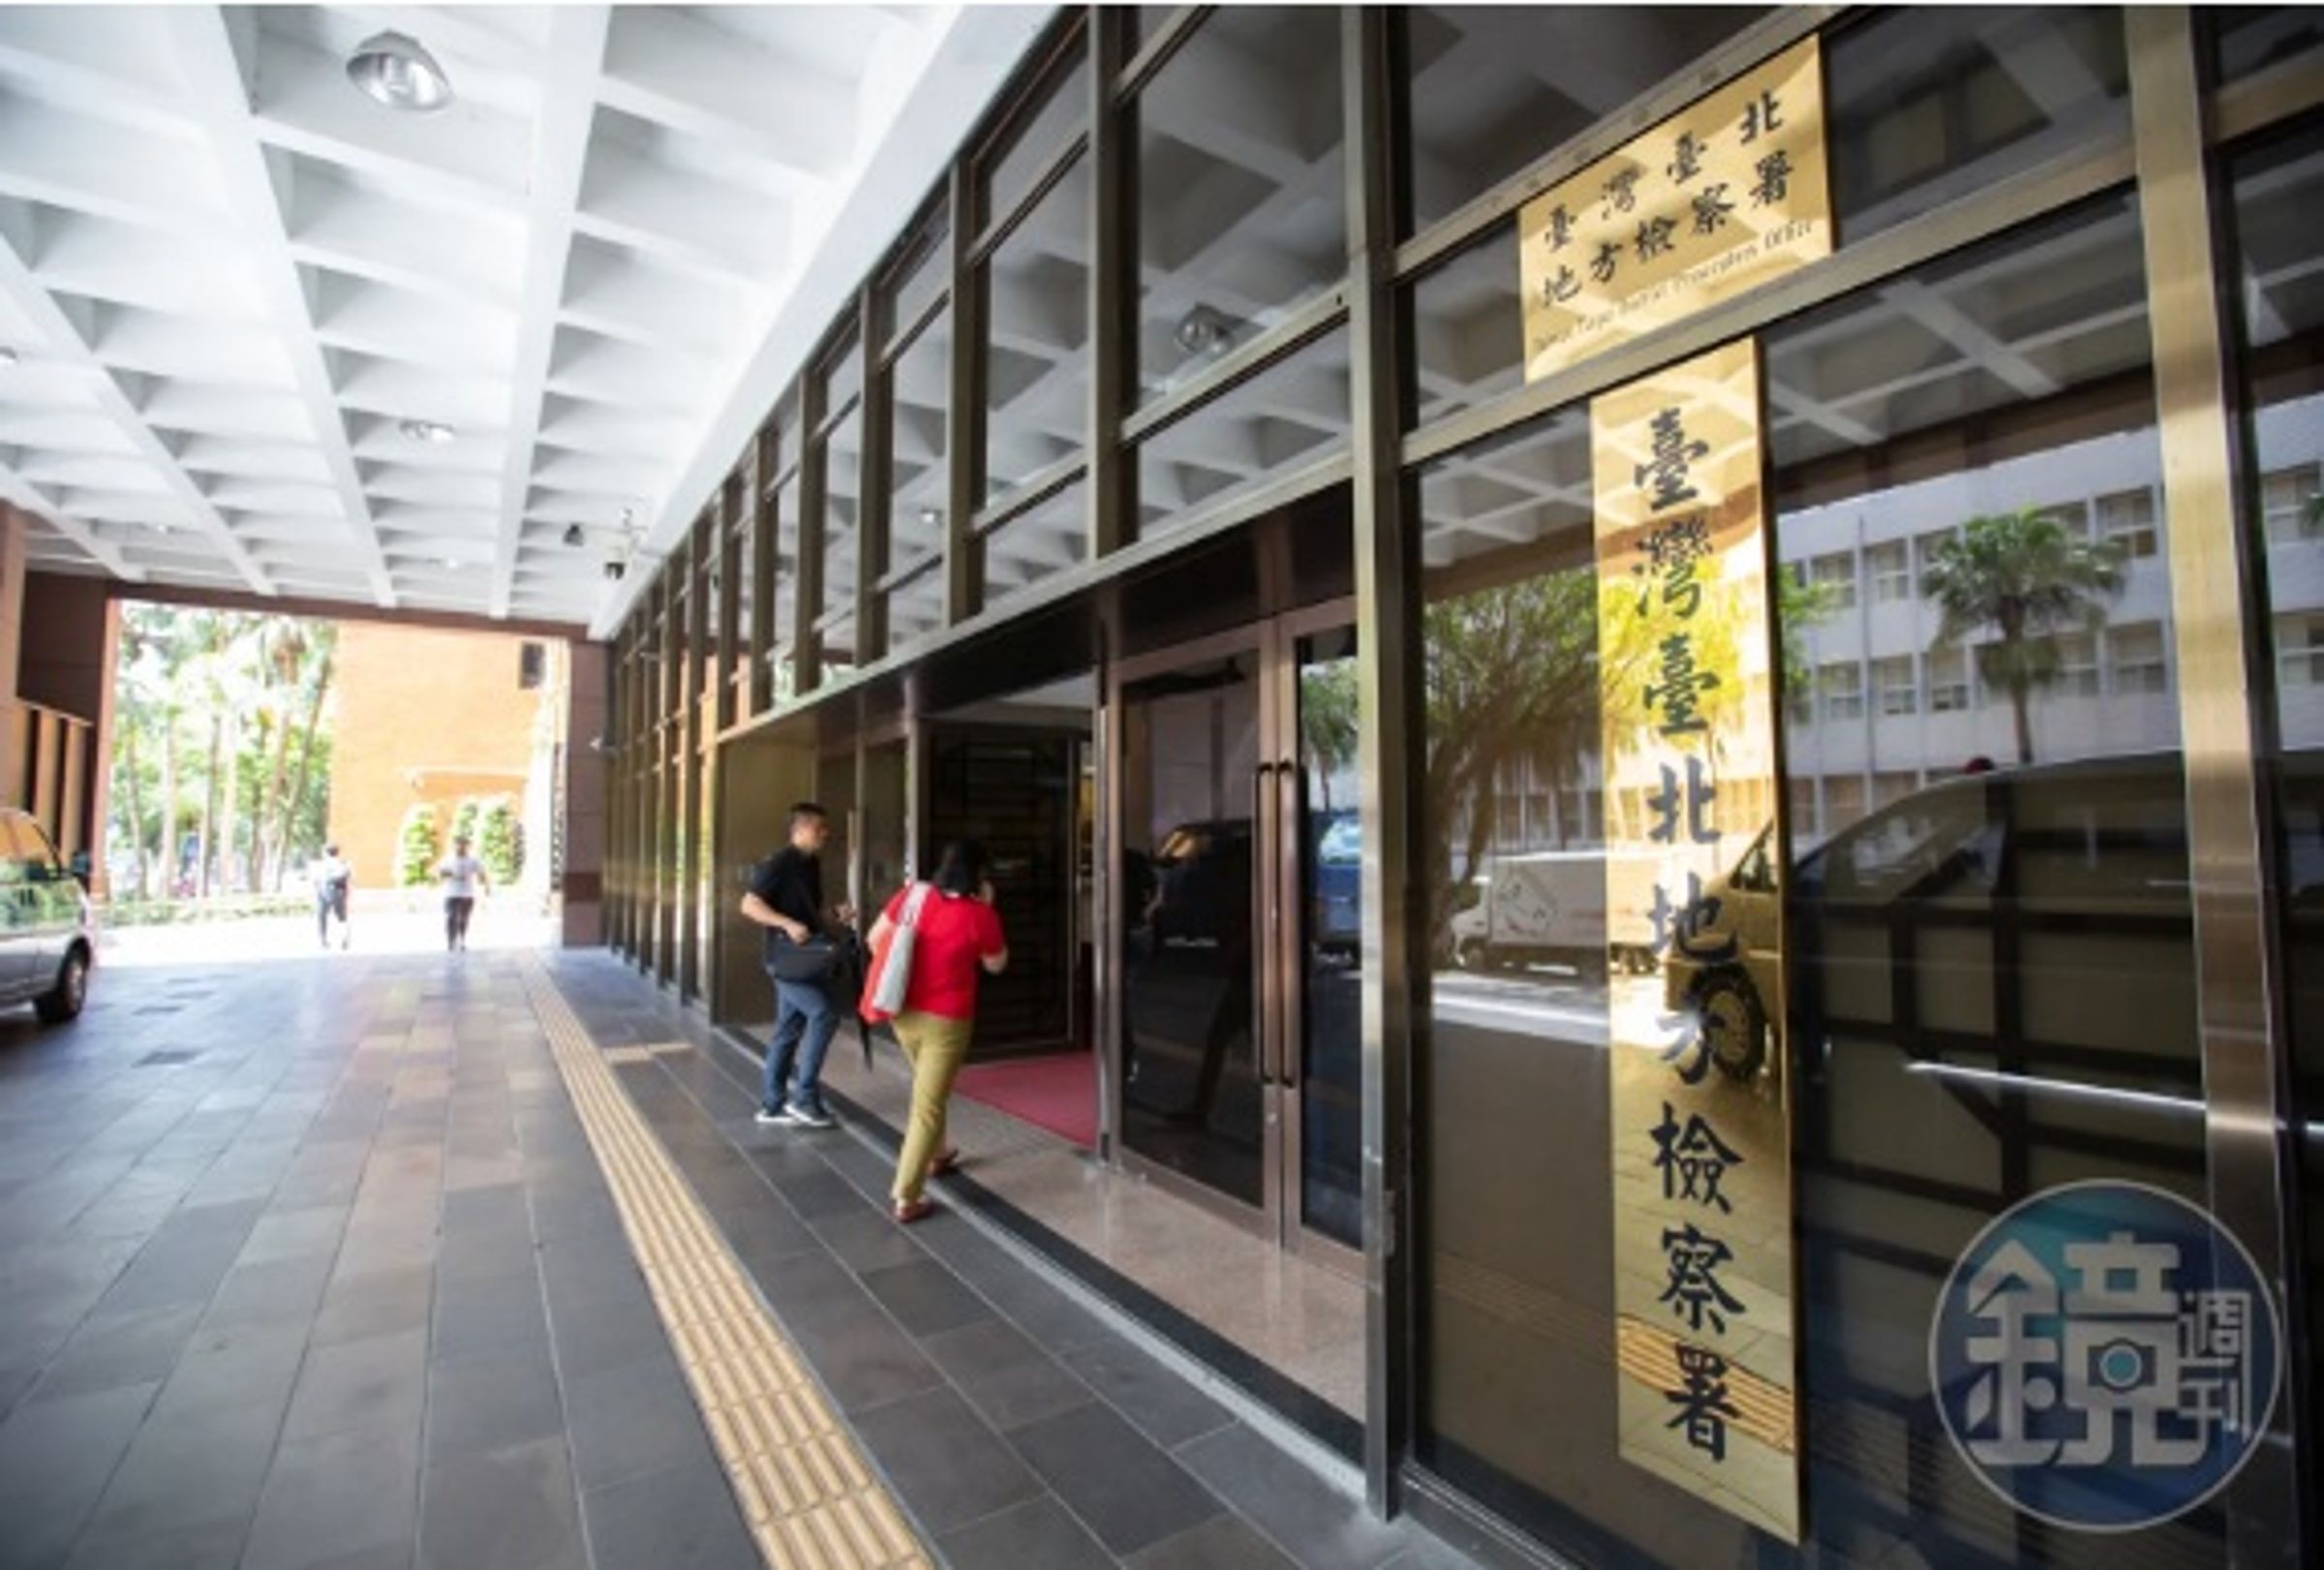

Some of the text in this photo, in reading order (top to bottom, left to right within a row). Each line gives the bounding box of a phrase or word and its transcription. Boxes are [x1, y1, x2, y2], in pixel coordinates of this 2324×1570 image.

[1543, 149, 1796, 309] 地方檢察署
[1544, 88, 1785, 253] 臺灣臺北
